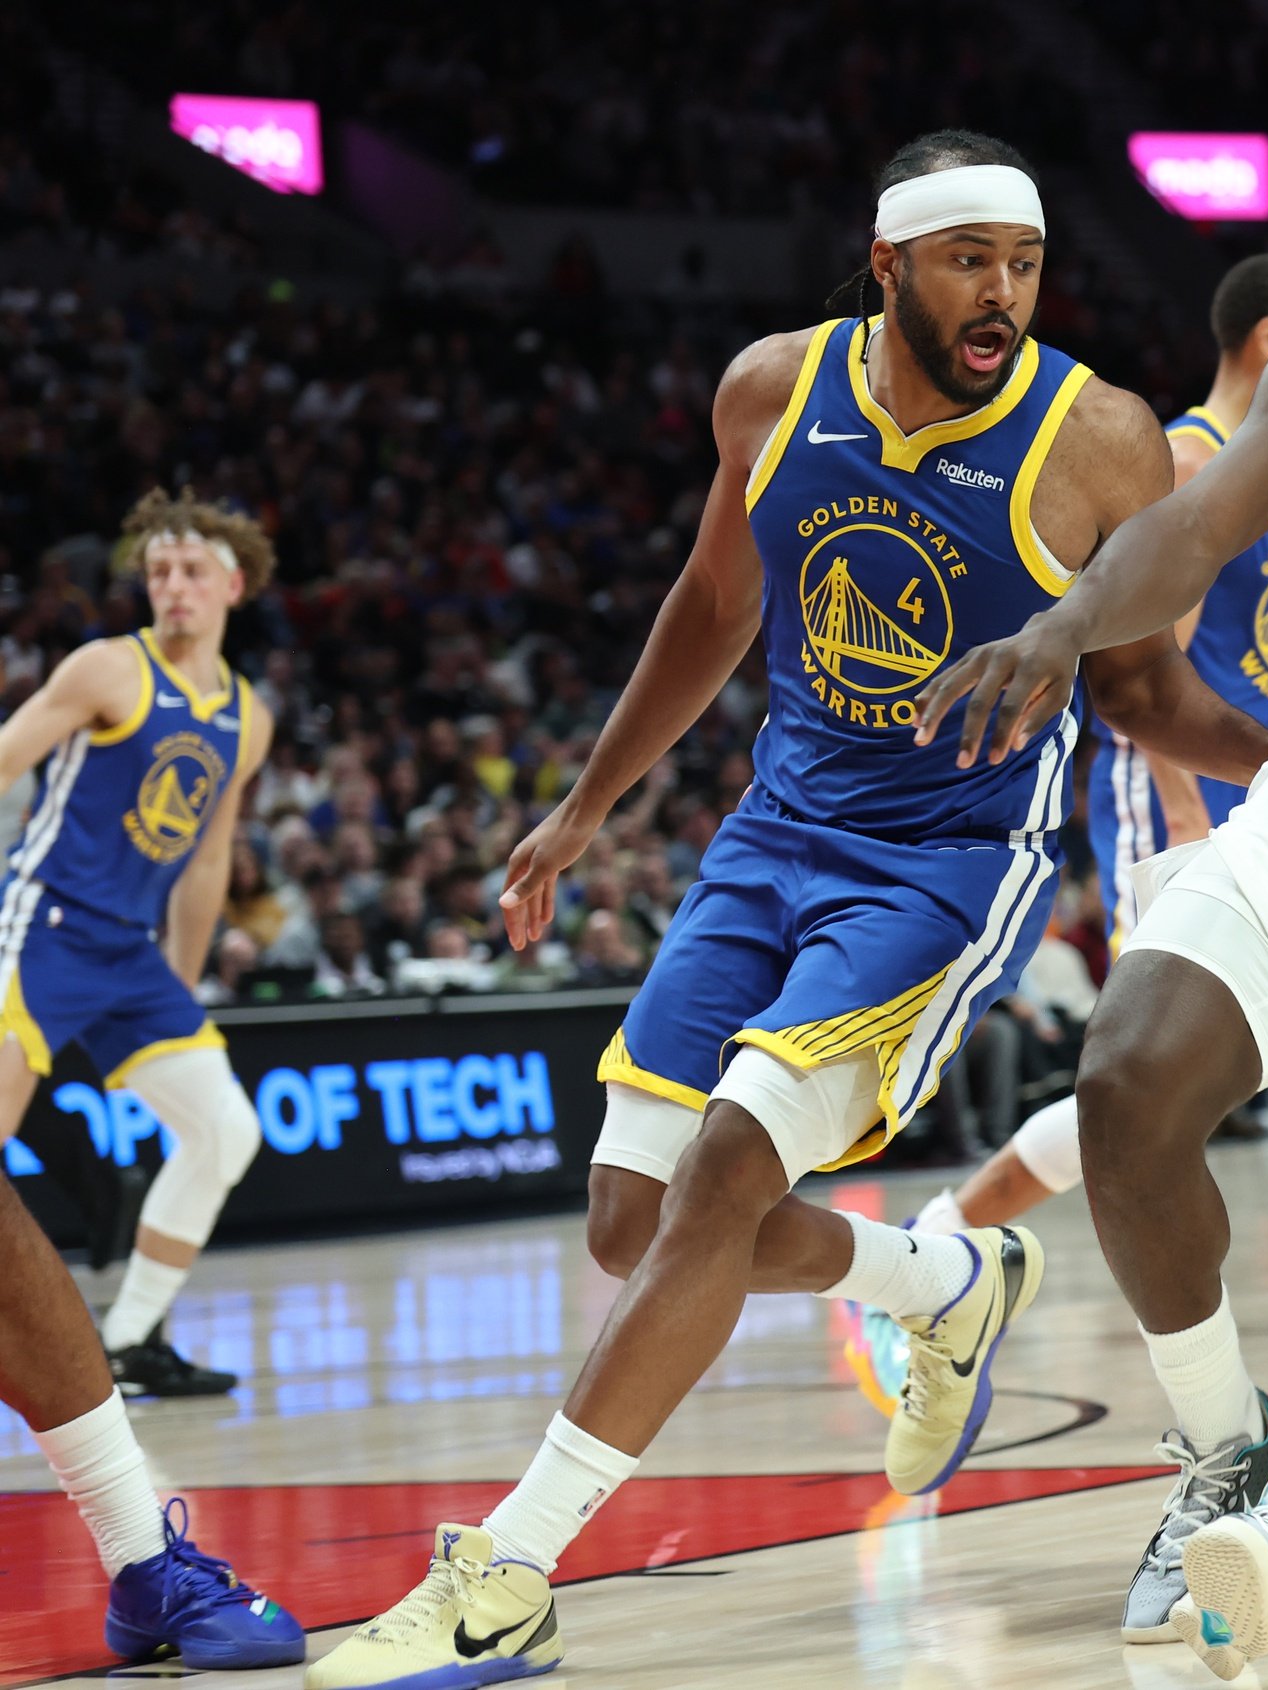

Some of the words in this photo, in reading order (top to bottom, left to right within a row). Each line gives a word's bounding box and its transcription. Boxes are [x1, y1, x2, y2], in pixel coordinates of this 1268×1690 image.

[936, 458, 1005, 492] Rakuten
[797, 496, 898, 538] GOLDEN
[907, 511, 969, 580] STATE
[896, 576, 926, 625] 4
[801, 637, 918, 728] WARRIO
[256, 1066, 361, 1155] OF
[364, 1050, 556, 1145] TECH
